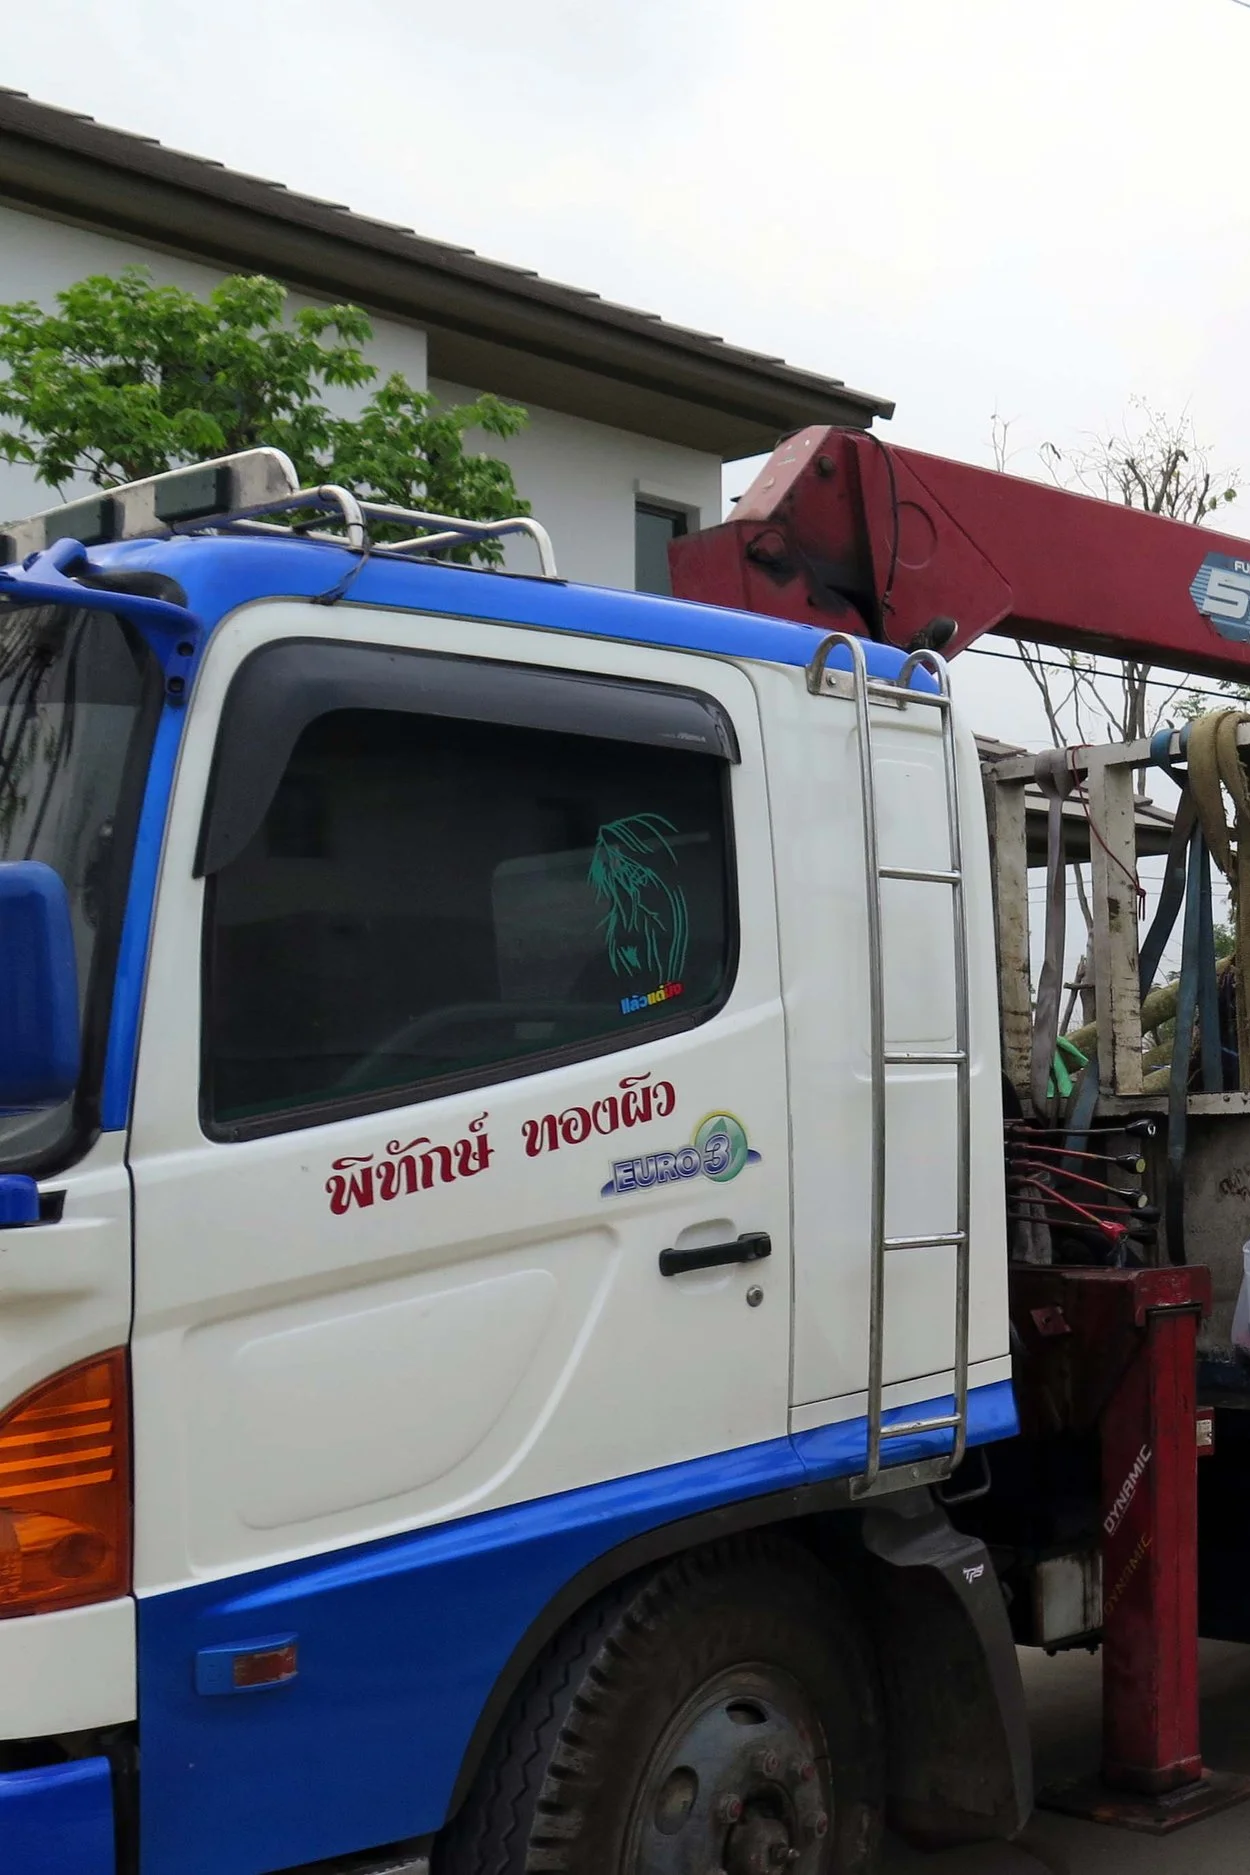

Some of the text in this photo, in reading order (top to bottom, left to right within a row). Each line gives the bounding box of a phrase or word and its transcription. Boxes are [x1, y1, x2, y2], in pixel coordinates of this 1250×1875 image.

[324, 1071, 676, 1215] พิทักษ์ ทองผิว
[613, 1132, 731, 1193] EURO 3
[1103, 1443, 1153, 1533] DYNAMIC
